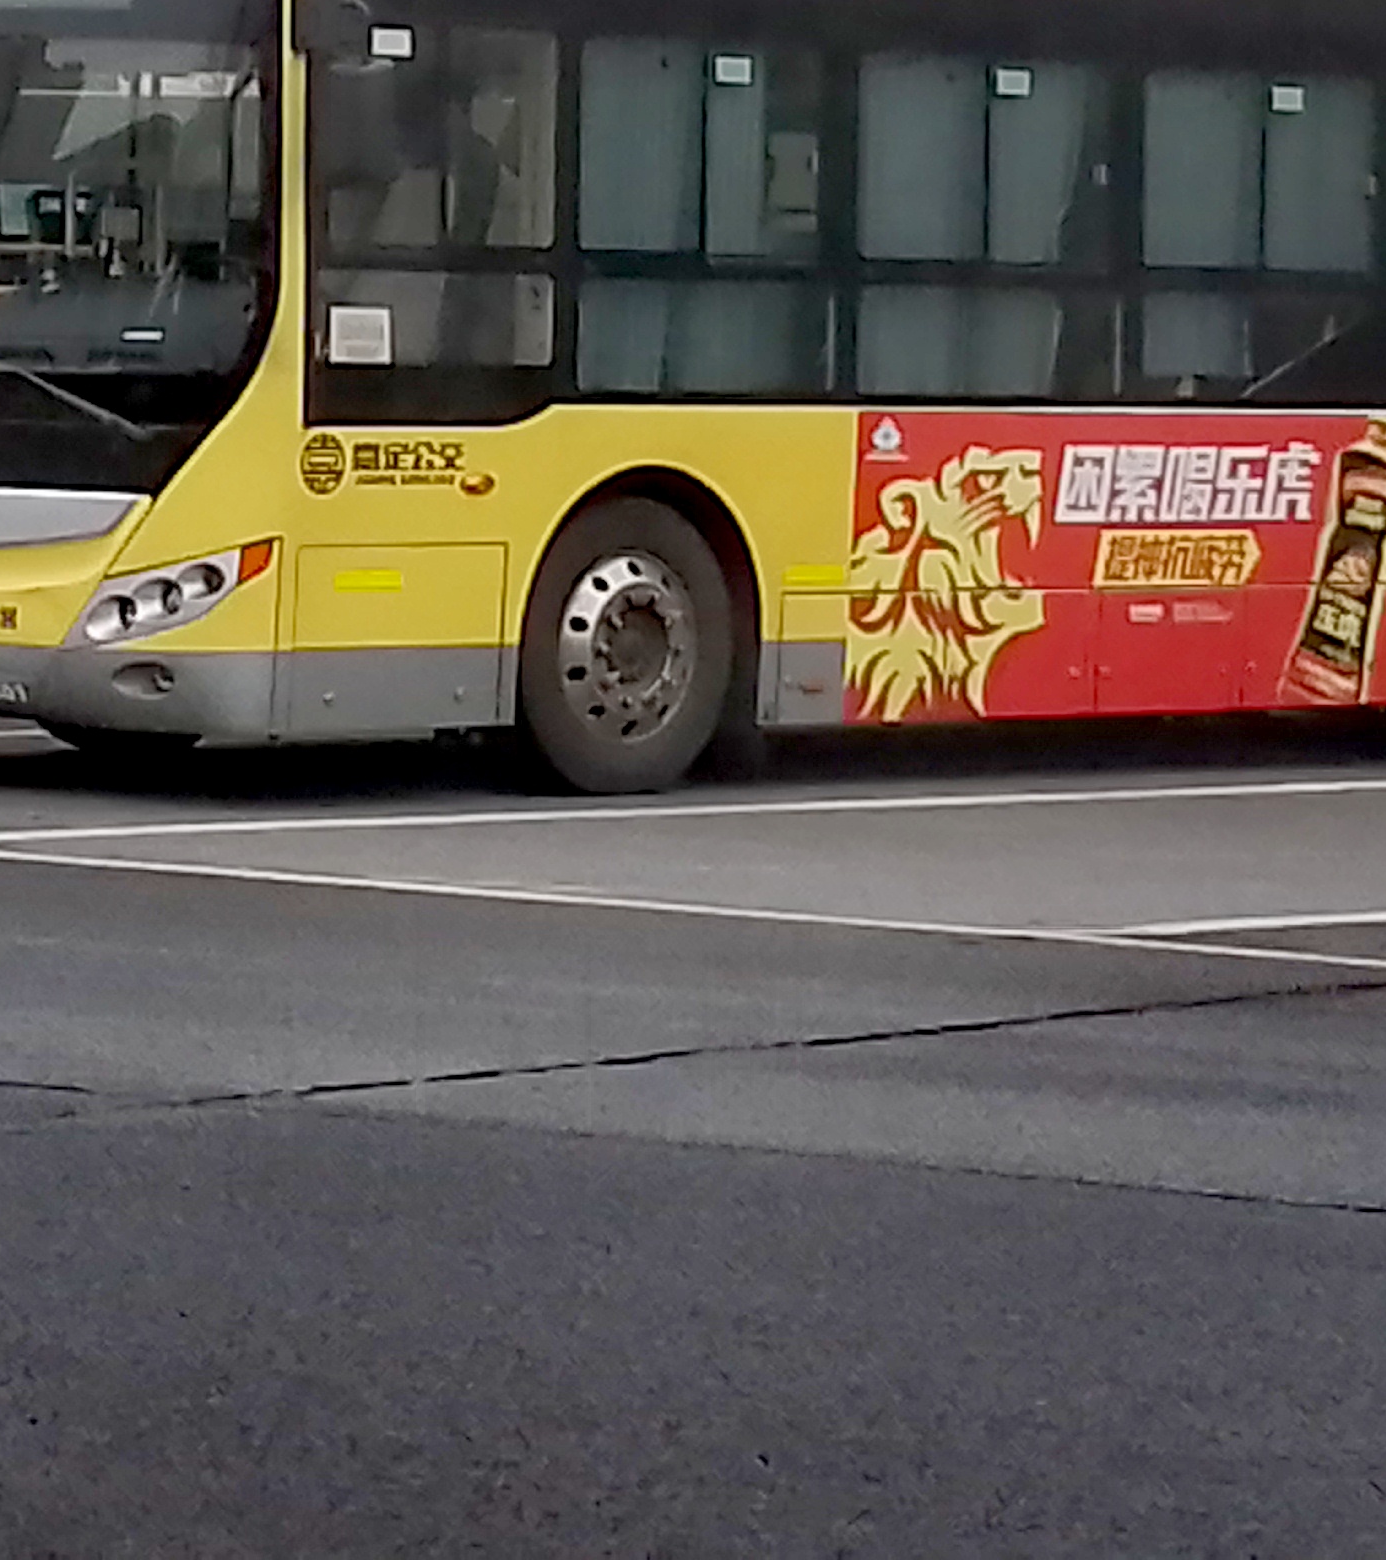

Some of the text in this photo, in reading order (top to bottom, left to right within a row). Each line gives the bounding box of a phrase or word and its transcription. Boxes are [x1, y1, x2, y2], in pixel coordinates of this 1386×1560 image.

[1054, 441, 1321, 523] 困累喝乐虎
